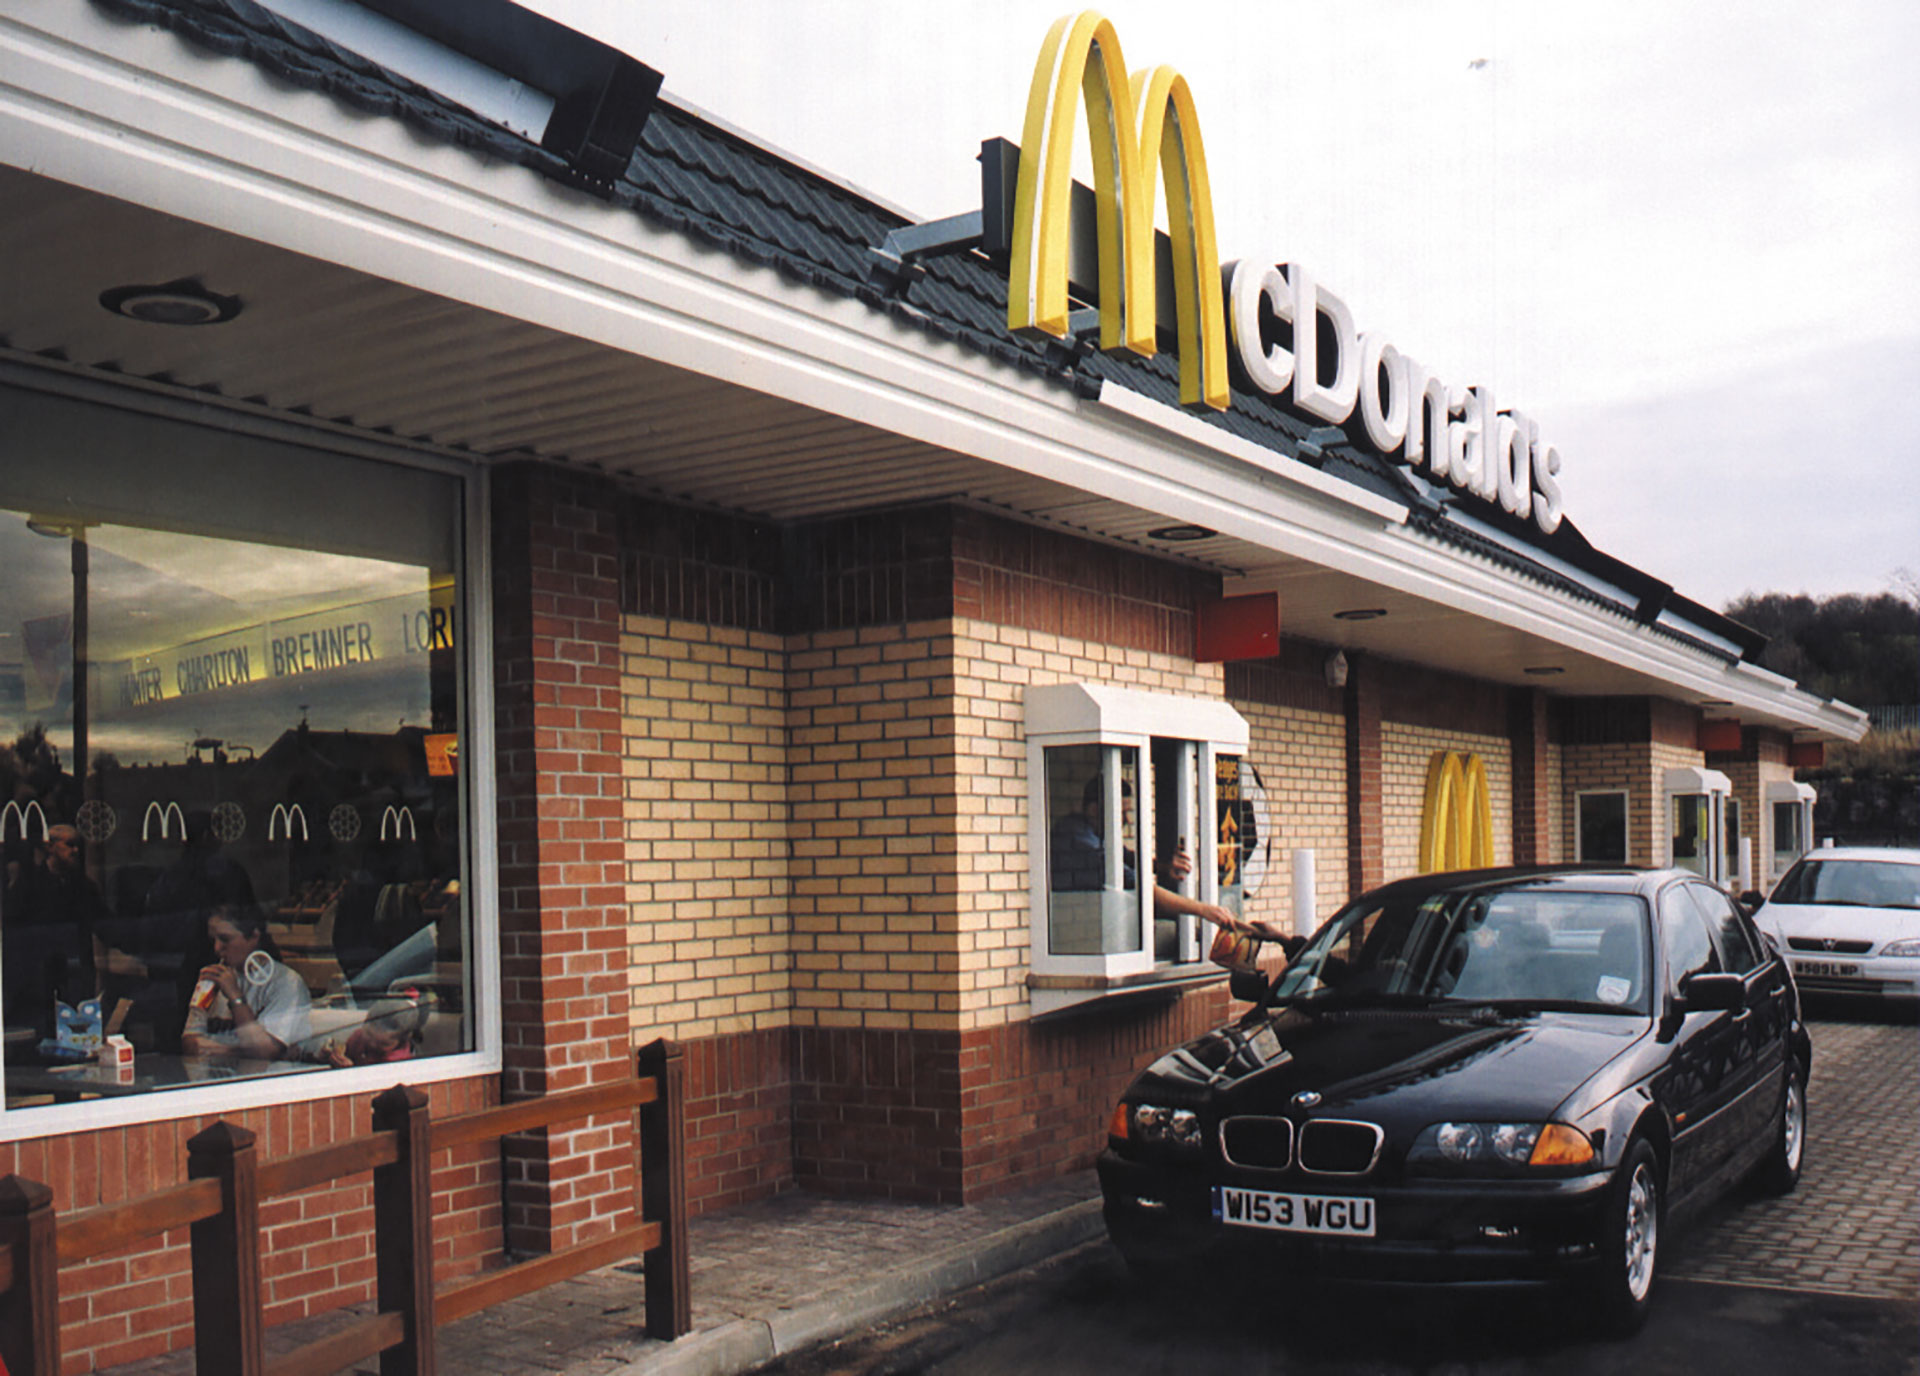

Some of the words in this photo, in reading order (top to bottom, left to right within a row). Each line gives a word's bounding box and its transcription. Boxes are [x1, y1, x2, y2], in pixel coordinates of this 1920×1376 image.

[177, 645, 250, 695] CHARLTON
[272, 621, 374, 676] BREMNER
[1226, 1190, 1294, 1225] W153
[1304, 1198, 1370, 1231] WGU
